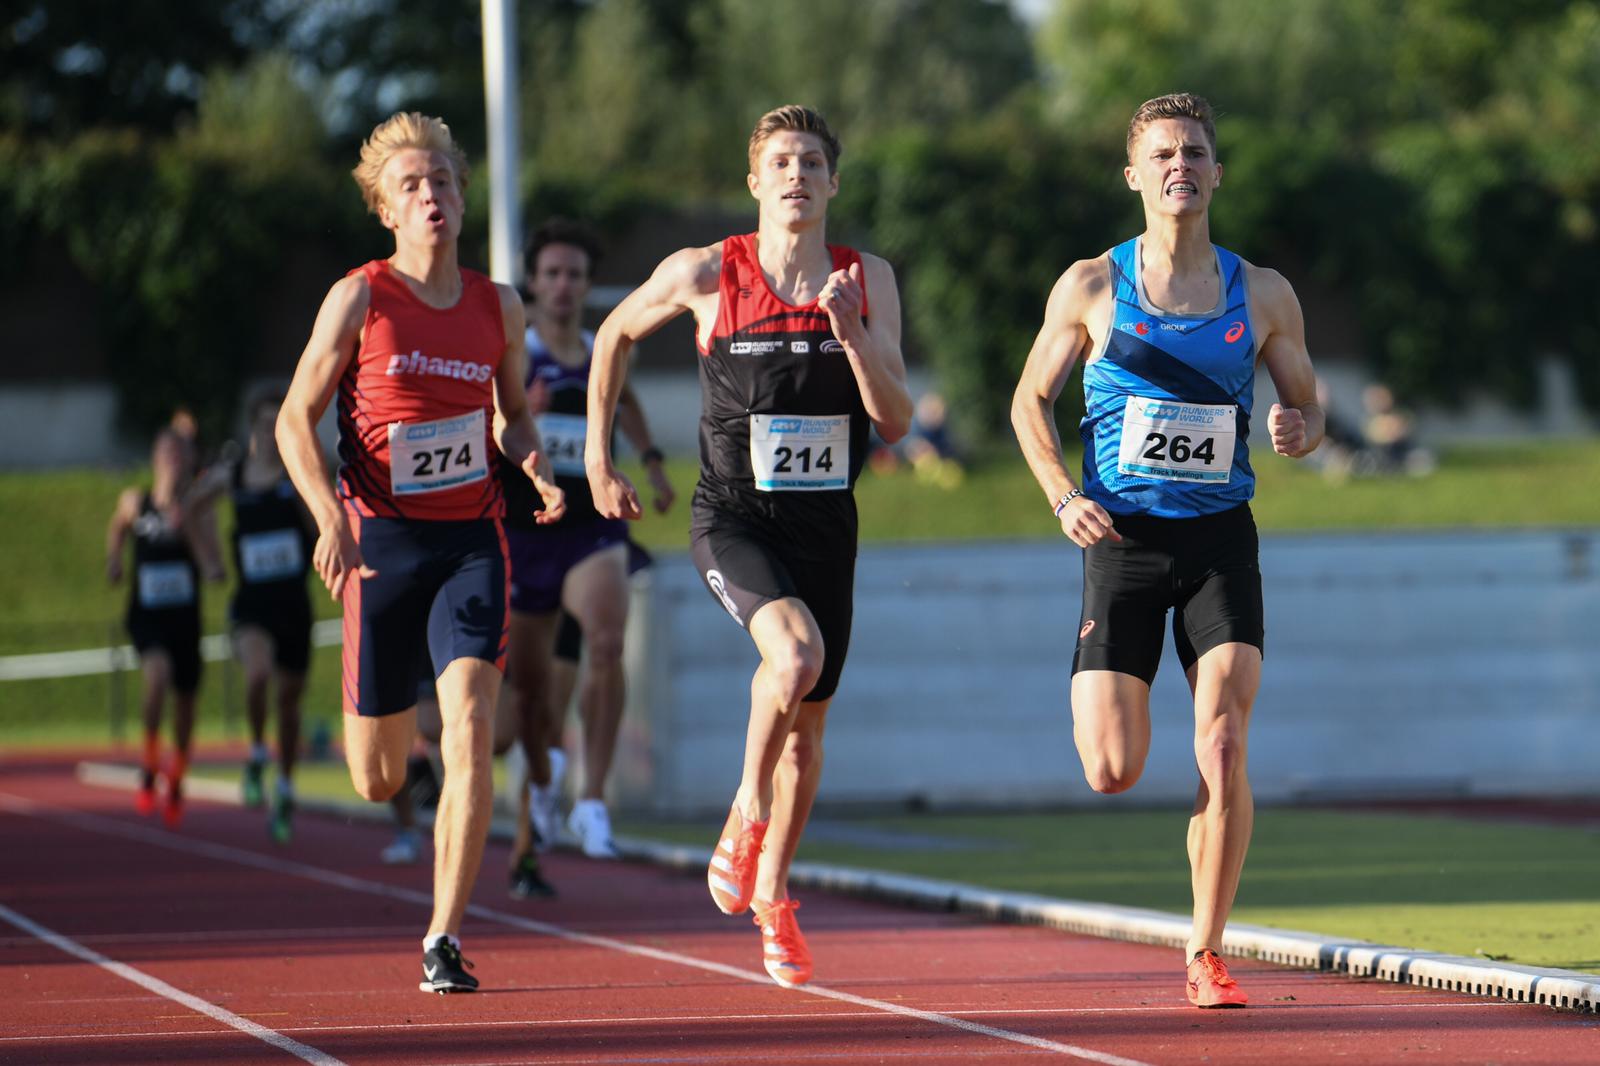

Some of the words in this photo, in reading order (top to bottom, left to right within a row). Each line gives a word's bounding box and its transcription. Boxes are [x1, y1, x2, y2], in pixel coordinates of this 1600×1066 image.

[1120, 322, 1134, 331] CTS
[1160, 323, 1187, 331] GROUP
[385, 350, 492, 382] phanos
[1179, 414, 1214, 424] WORLD
[1180, 406, 1225, 417] RUNNERS
[546, 436, 585, 458] 24
[1142, 432, 1215, 465] 264
[412, 442, 472, 476] 274
[773, 446, 833, 473] 214
[1150, 467, 1170, 477] Track
[1171, 470, 1204, 480] Meetings
